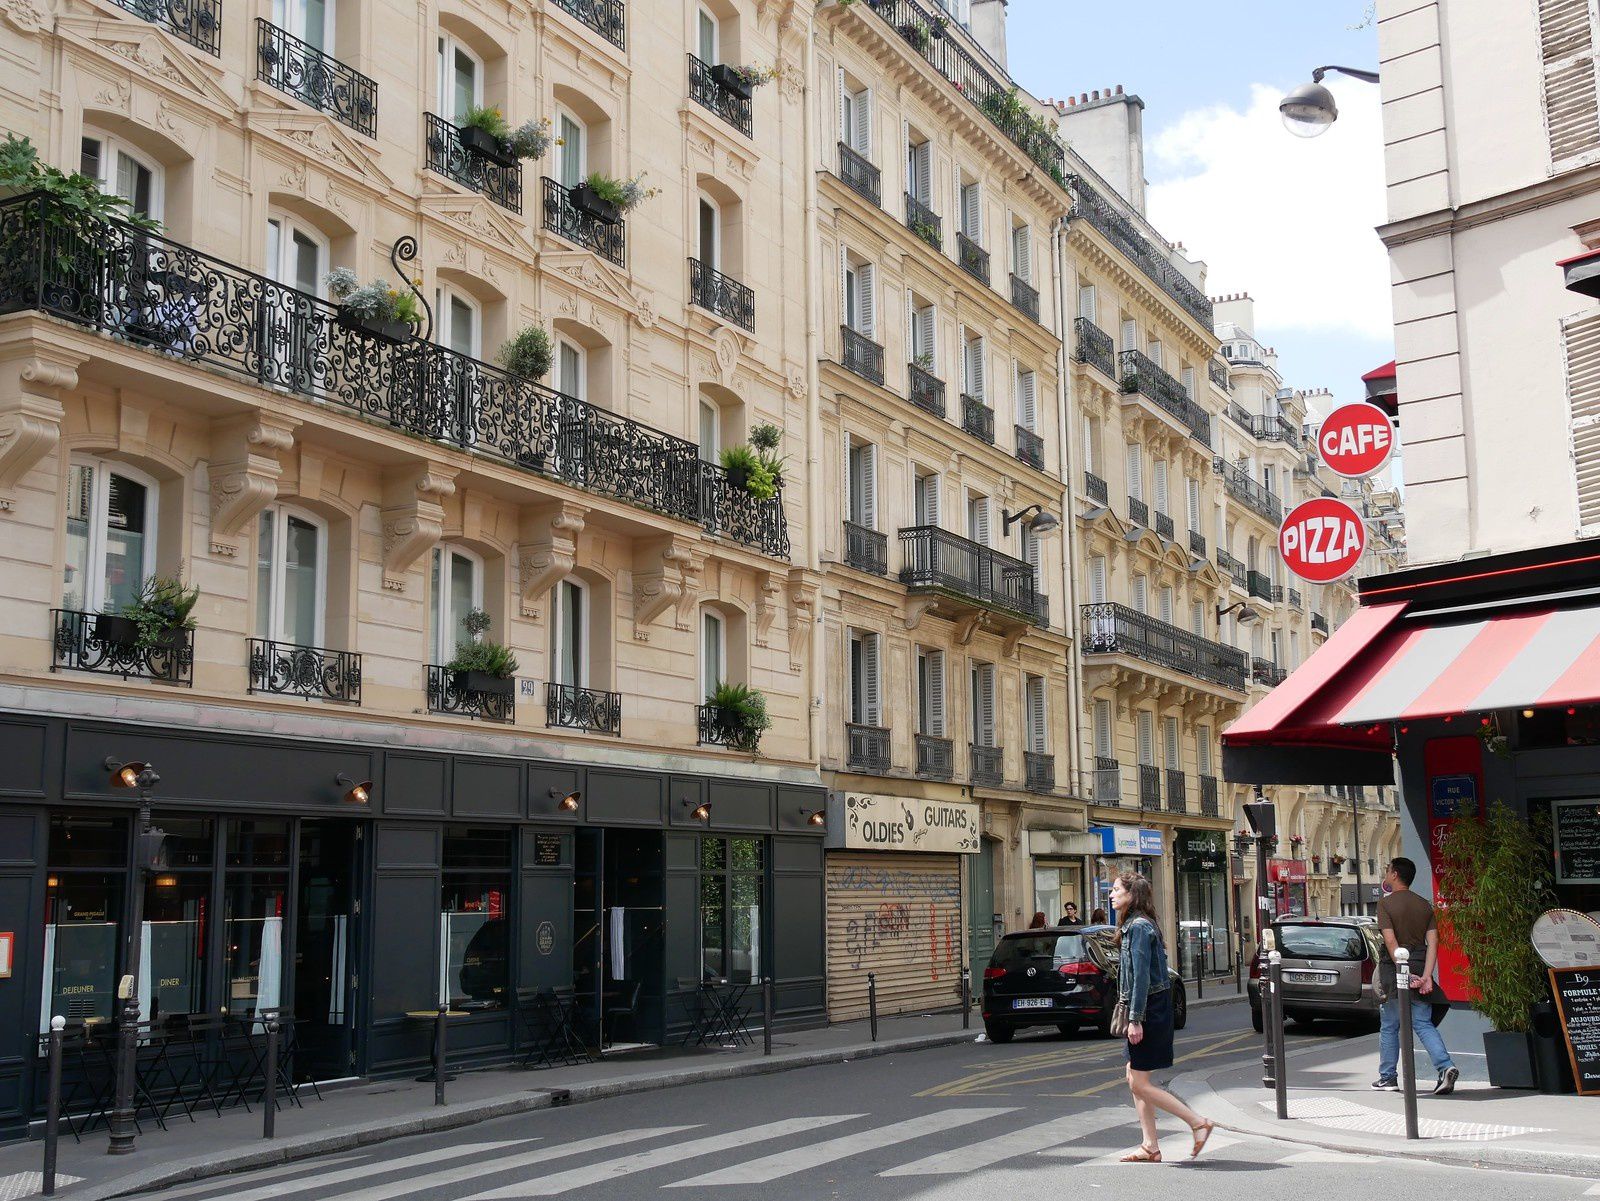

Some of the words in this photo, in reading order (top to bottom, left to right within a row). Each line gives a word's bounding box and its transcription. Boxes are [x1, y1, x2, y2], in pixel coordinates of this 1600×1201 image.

[1322, 424, 1389, 456] CAFE
[1283, 516, 1361, 564] PIZZA
[1437, 798, 1455, 806] VICTOR
[924, 806, 967, 829] GUITARS
[862, 820, 905, 844] OLDIES
[160, 978, 180, 987] DINER
[1574, 973, 1589, 987] B9
[63, 985, 94, 995] DEJEUNER
[1563, 988, 1598, 997] FORMULE
